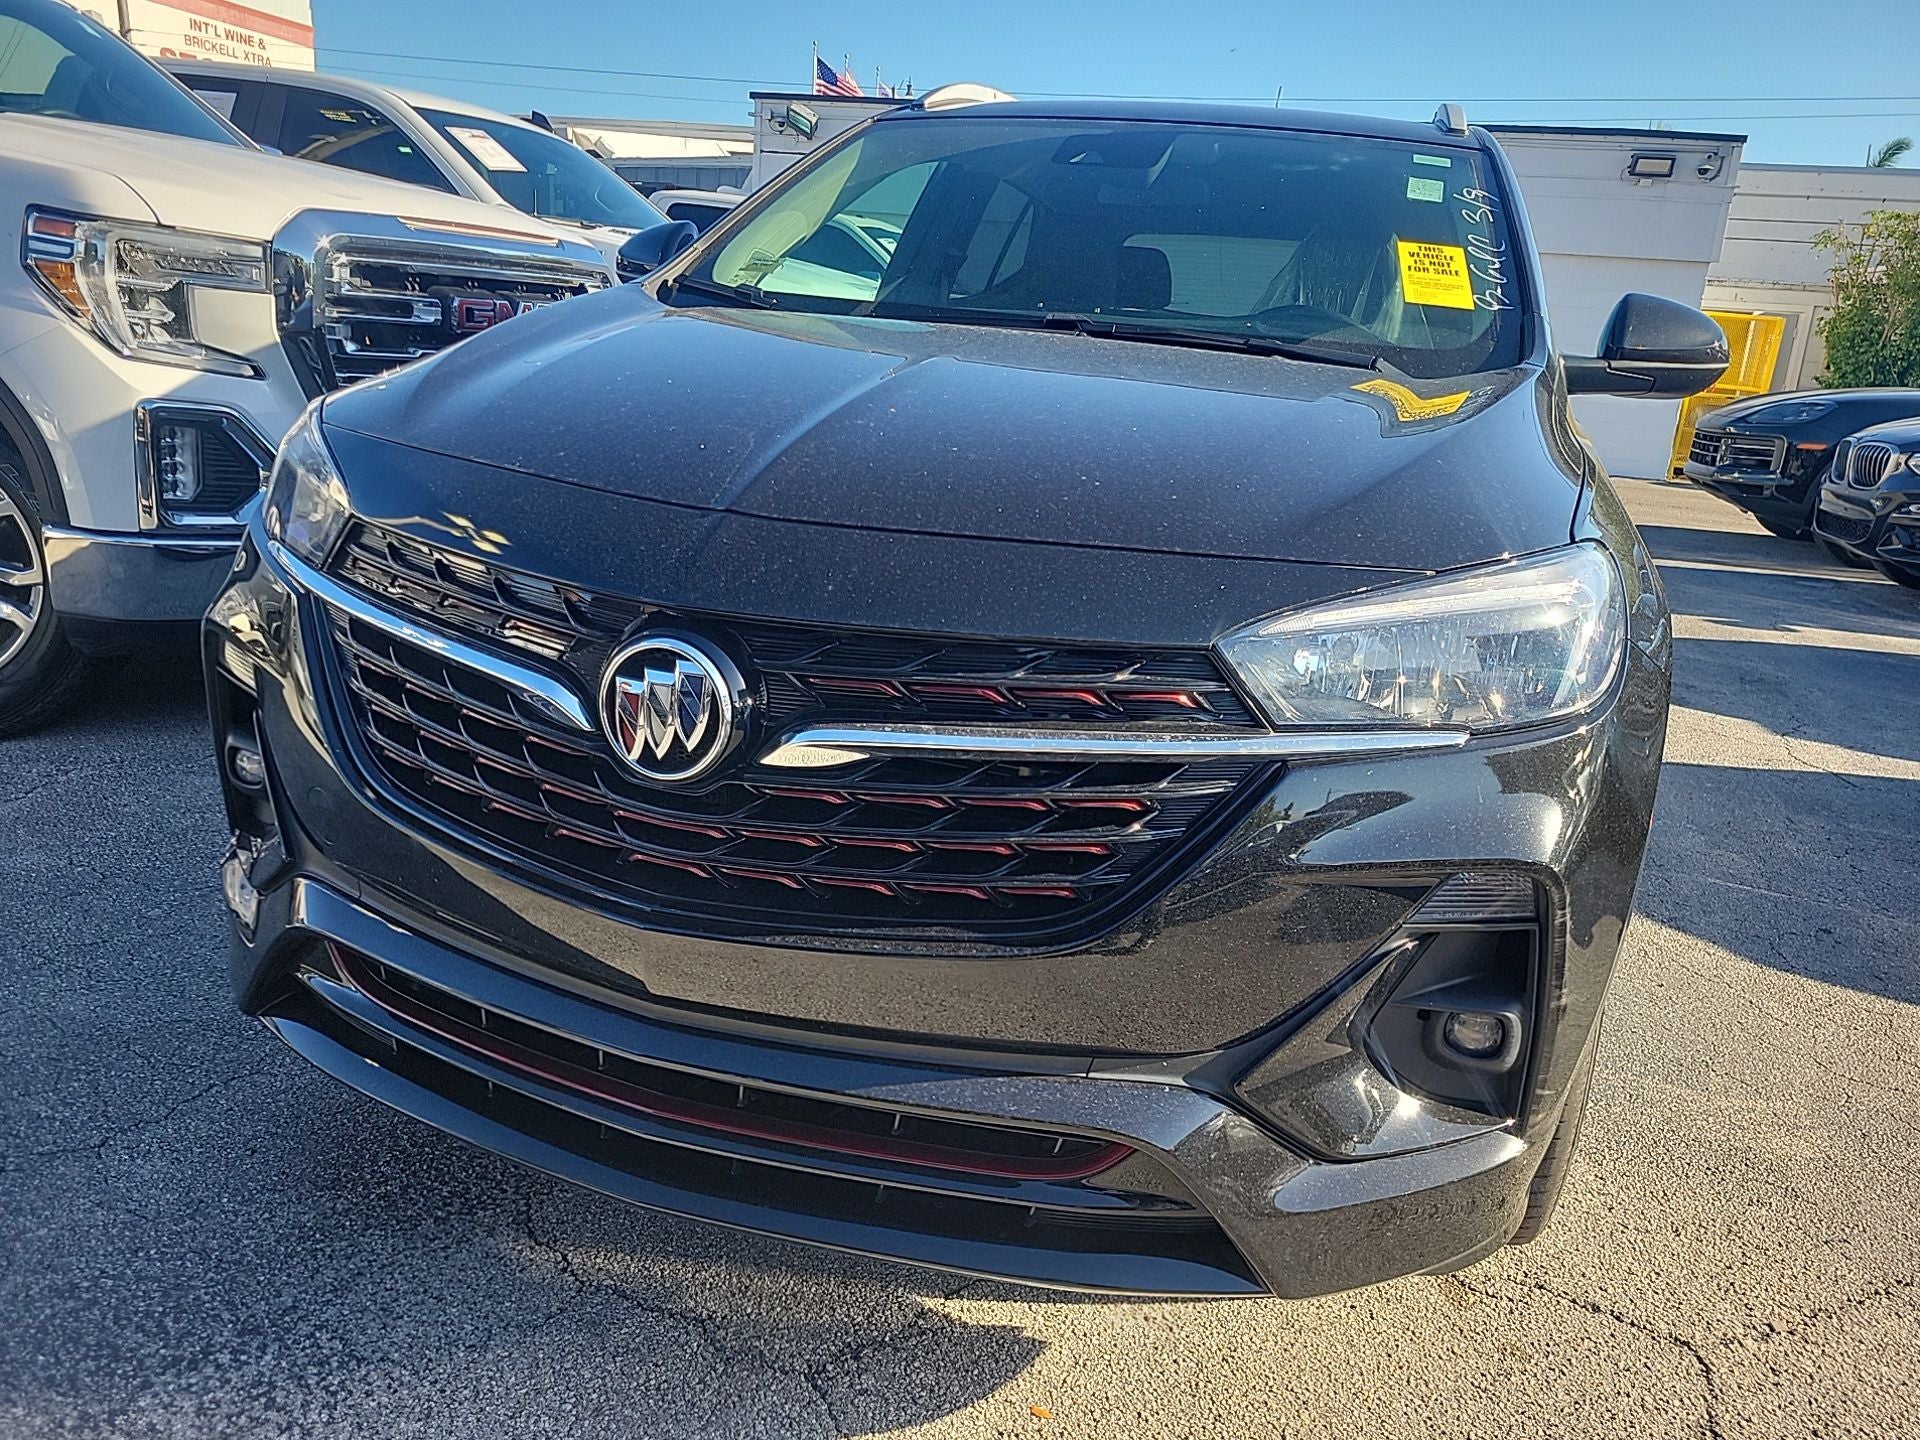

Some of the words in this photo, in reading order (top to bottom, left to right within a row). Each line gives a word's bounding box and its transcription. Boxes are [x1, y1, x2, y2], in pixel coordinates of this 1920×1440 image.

[188, 17, 222, 38] INT'L
[223, 27, 255, 48] WINE
[257, 38, 268, 51] &
[184, 34, 239, 60] BRICKELL
[243, 50, 272, 68] XTRA
[1417, 245, 1444, 254] THIS
[1408, 251, 1456, 263] VEHICLE
[1429, 260, 1452, 269] NOT
[1408, 265, 1430, 274] FOR
[1432, 267, 1462, 277] SALE
[455, 297, 552, 332] GM
